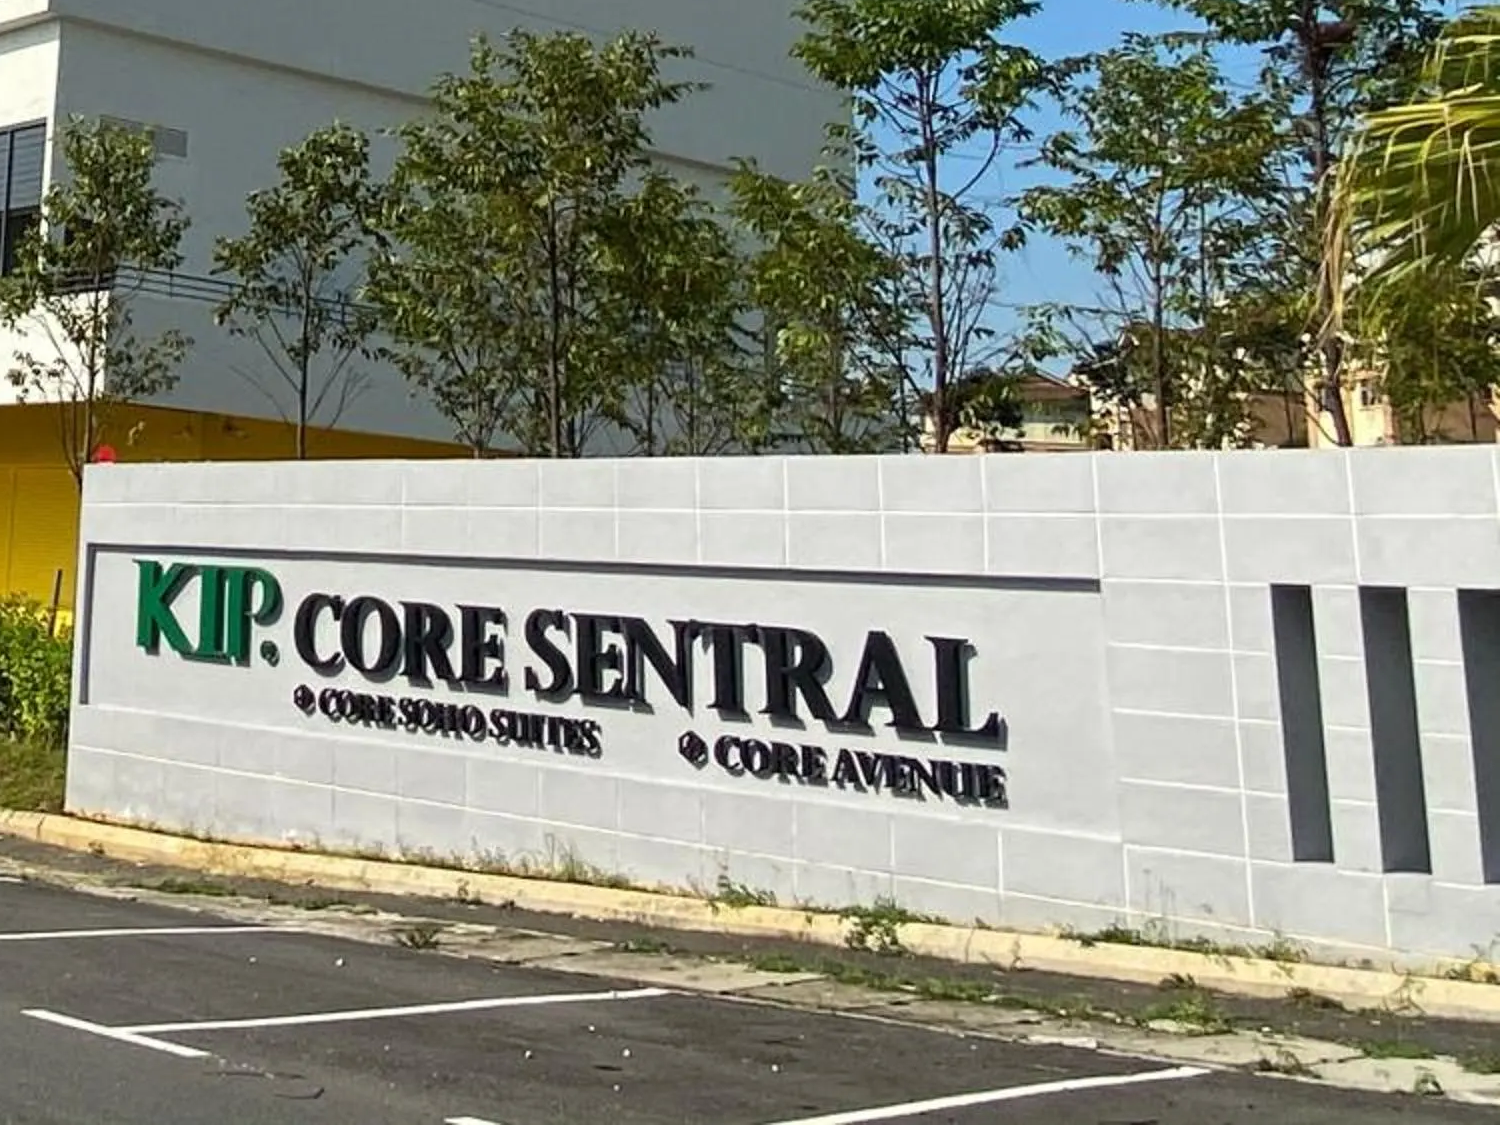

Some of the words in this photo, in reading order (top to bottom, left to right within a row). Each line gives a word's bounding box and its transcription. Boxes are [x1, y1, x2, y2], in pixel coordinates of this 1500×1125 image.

[294, 593, 509, 696] CORE
[524, 608, 1008, 751] SENTRAL
[319, 688, 396, 729] CORE
[398, 698, 487, 742] SOHO
[489, 708, 602, 759] SUITES
[714, 735, 829, 787] CORE
[830, 748, 1009, 810] AVENUE
